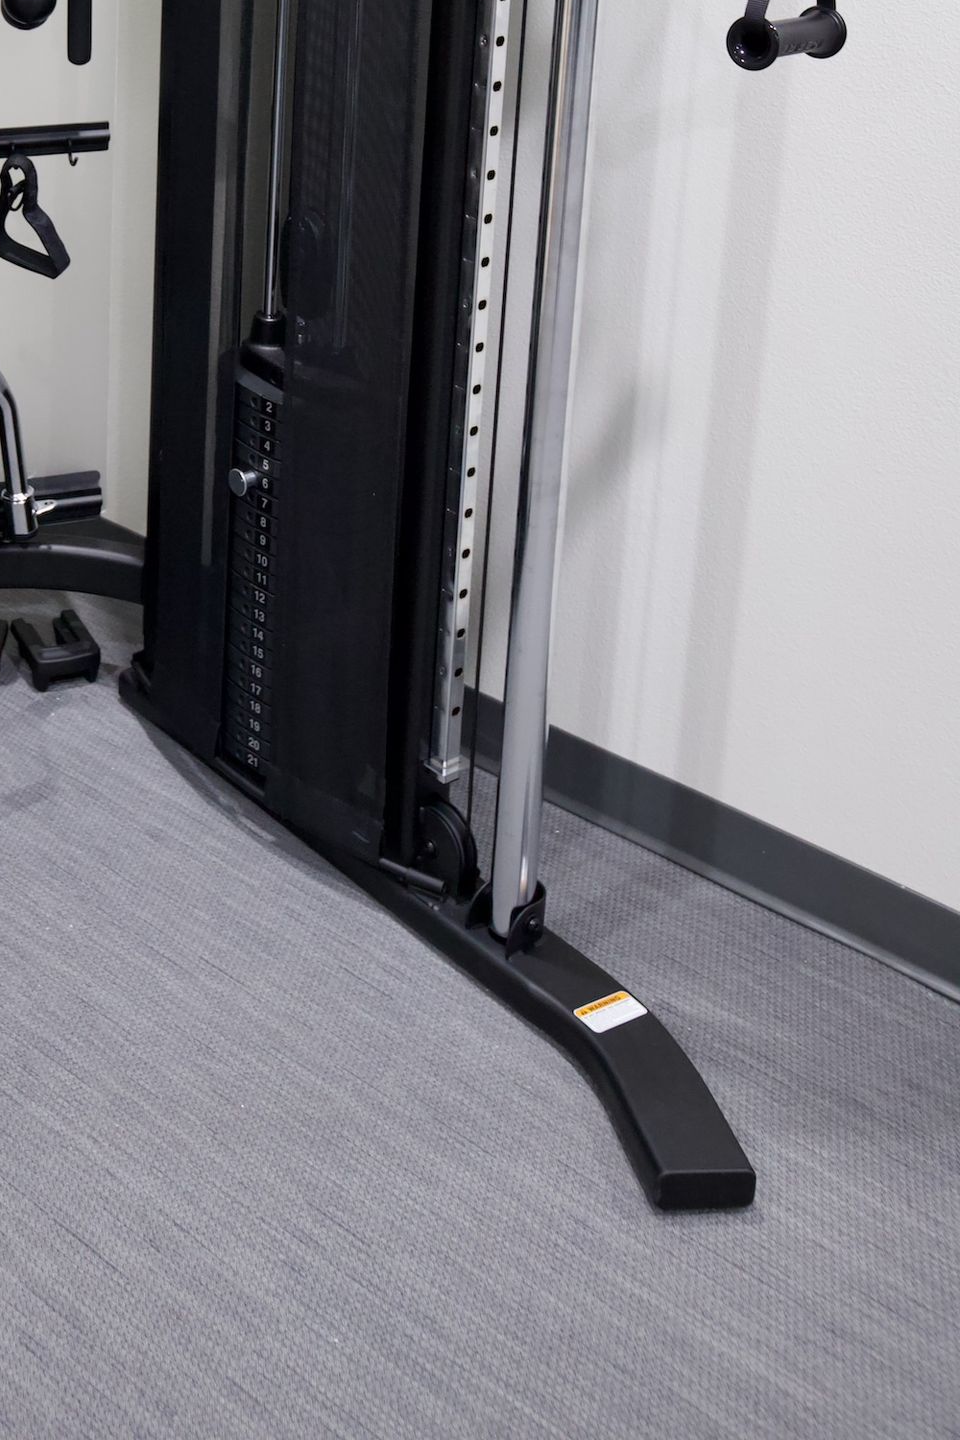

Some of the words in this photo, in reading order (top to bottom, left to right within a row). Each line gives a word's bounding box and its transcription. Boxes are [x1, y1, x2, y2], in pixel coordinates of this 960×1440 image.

[266, 402, 272, 413] 2
[264, 420, 271, 431] 3
[264, 440, 270, 451] 4
[262, 459, 269, 470] 5
[262, 478, 268, 488] 6
[261, 497, 268, 508] 7
[260, 516, 266, 527] 8
[259, 535, 266, 546] 9
[256, 554, 268, 567] 10
[256, 572, 266, 585] 11
[255, 592, 265, 604] 12
[254, 609, 265, 622] 13
[252, 628, 263, 640] 14
[252, 646, 264, 659] 15
[250, 664, 262, 678] 16
[250, 683, 262, 695] 17
[249, 701, 261, 714] 18
[249, 719, 260, 732] 19
[248, 737, 260, 751] 20
[247, 754, 258, 767] 21
